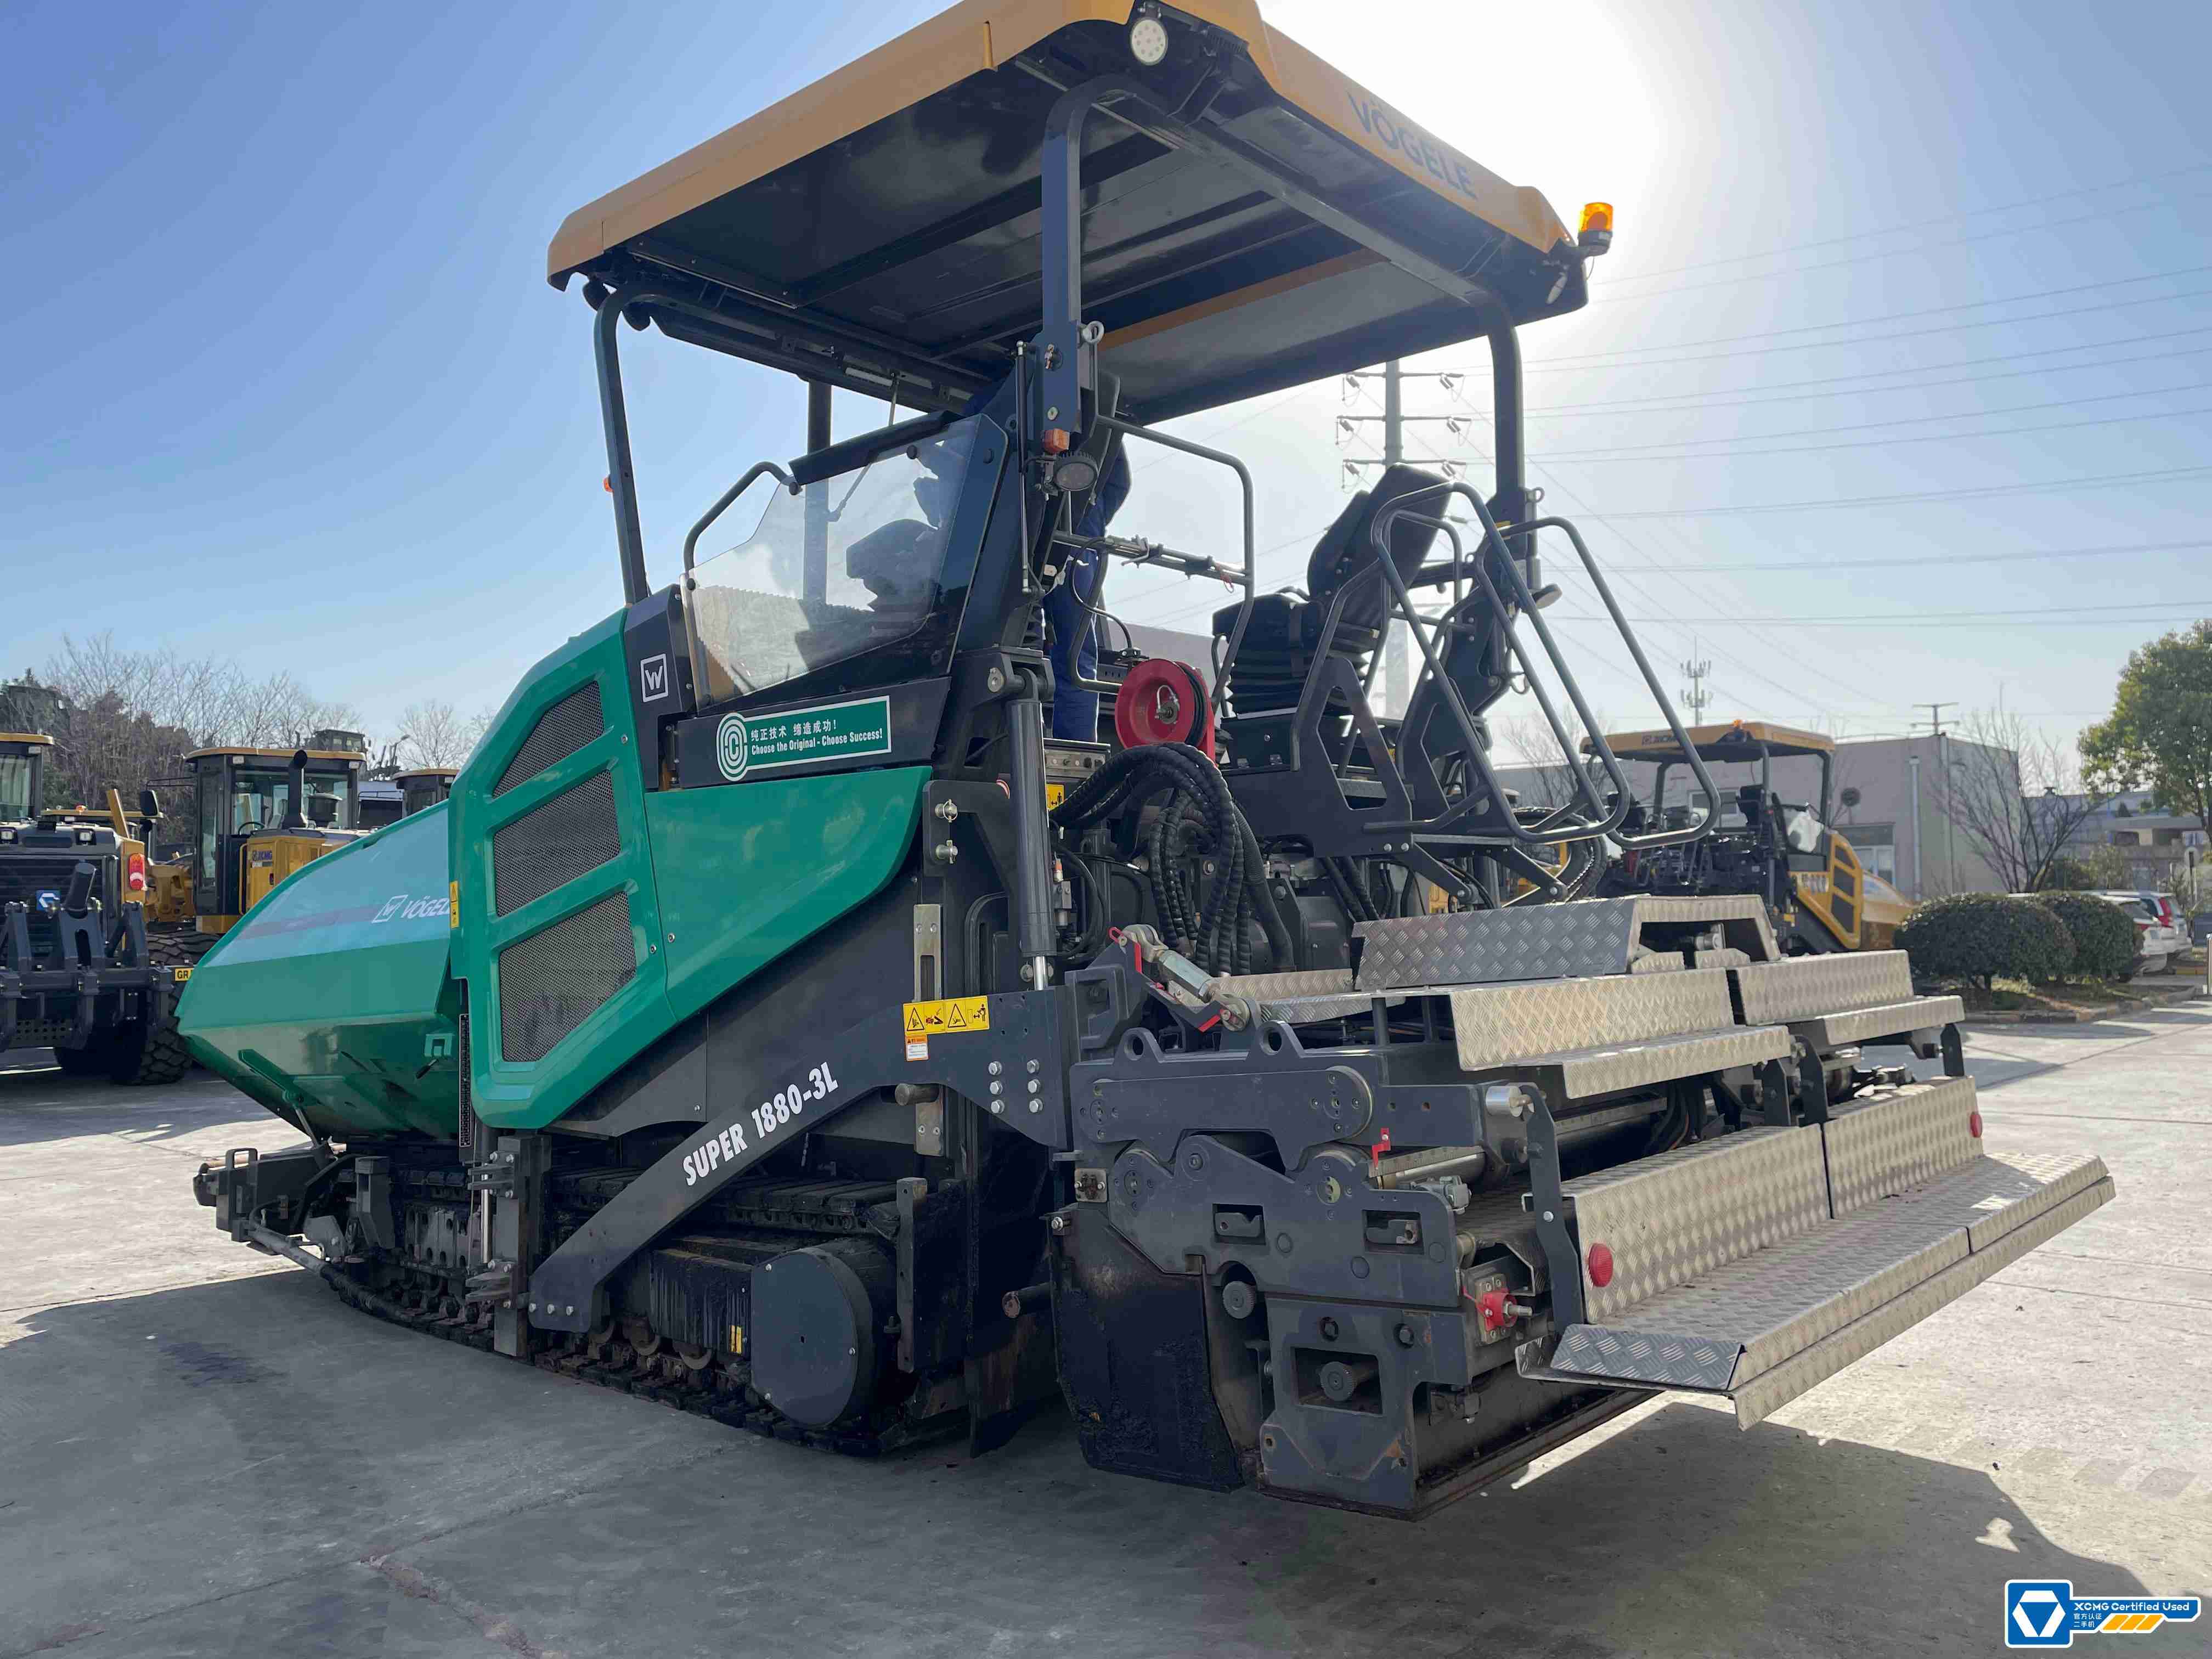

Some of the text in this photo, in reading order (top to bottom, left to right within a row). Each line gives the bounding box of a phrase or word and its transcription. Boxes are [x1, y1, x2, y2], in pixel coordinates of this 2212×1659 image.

[1346, 90, 1478, 200] VÖGELE
[751, 726, 787, 742] 纯正技术
[752, 744, 775, 755] Choose
[777, 742, 788, 752] the
[789, 737, 816, 751] Original
[822, 734, 848, 747] Choose
[850, 728, 883, 743] Success!
[400, 895, 450, 919] VÖGEL
[177, 970, 193, 979] GR
[683, 1062, 839, 1186] SUPER 1880-3L
